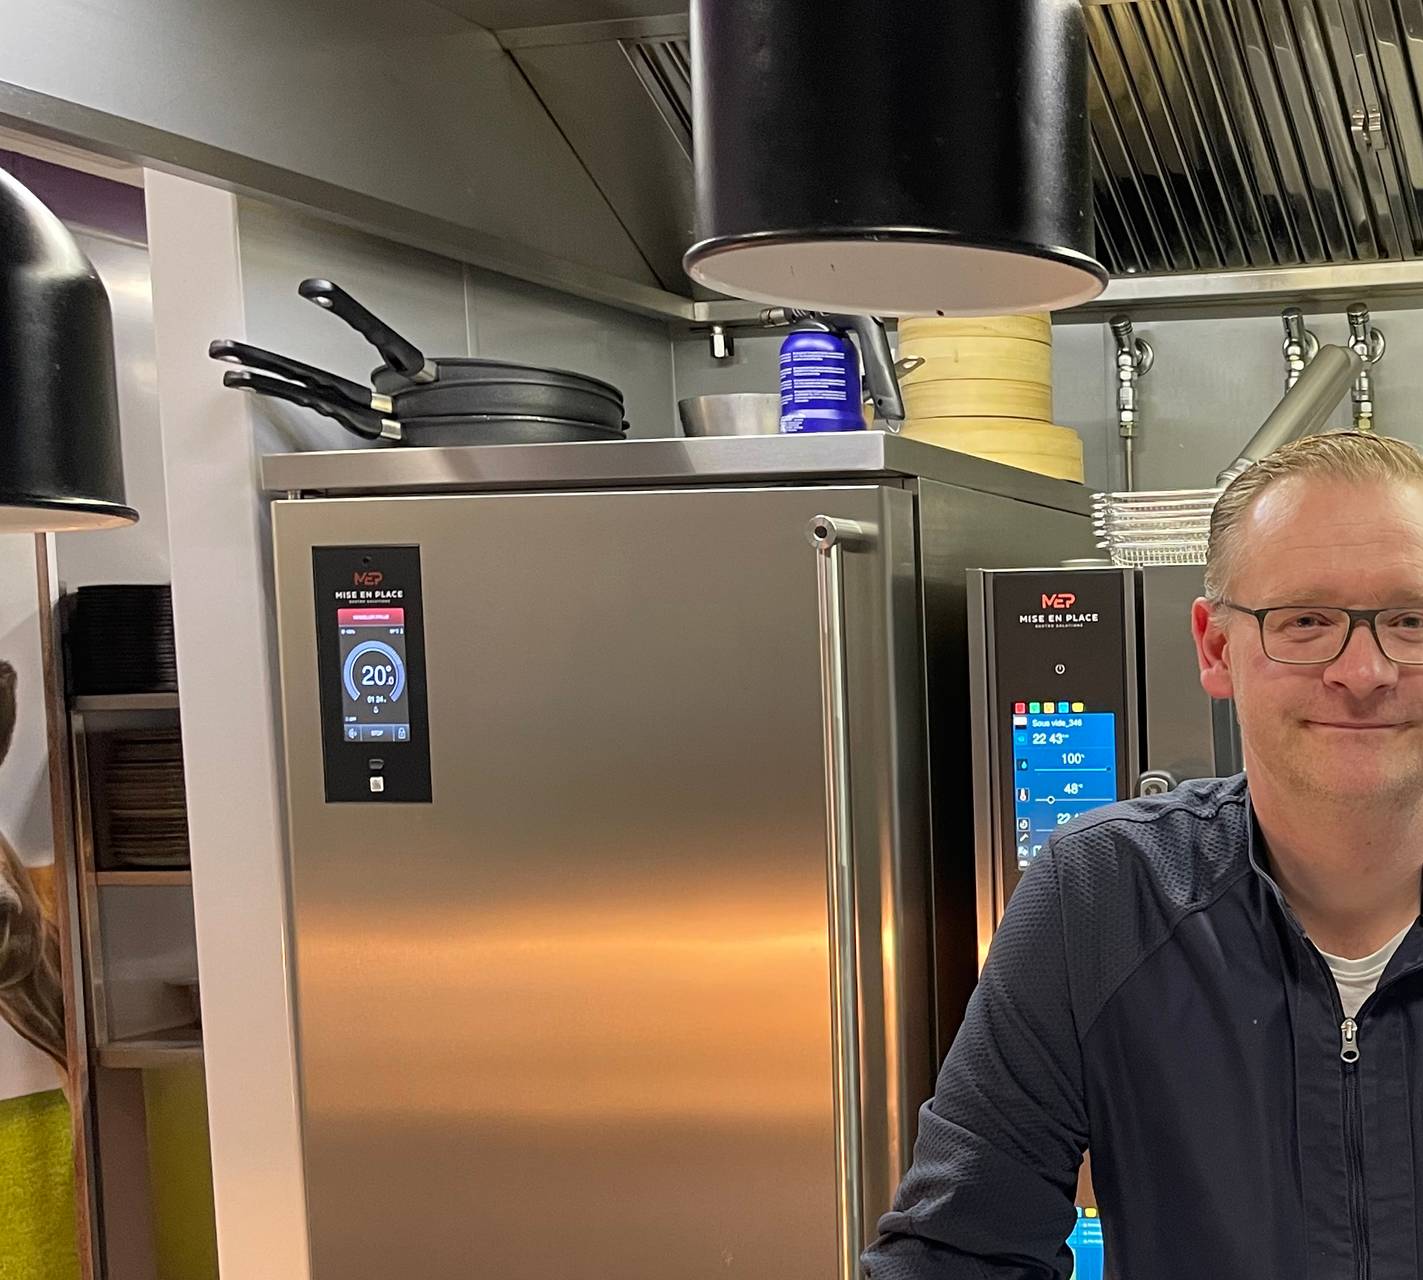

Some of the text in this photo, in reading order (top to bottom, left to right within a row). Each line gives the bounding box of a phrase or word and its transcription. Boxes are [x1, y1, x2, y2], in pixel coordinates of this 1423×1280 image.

[335, 589, 404, 599] MISE EN PLACE
[1041, 593, 1076, 609] MEP
[1019, 613, 1099, 623] MISE EN PLACE
[1032, 733, 1047, 745] 22
